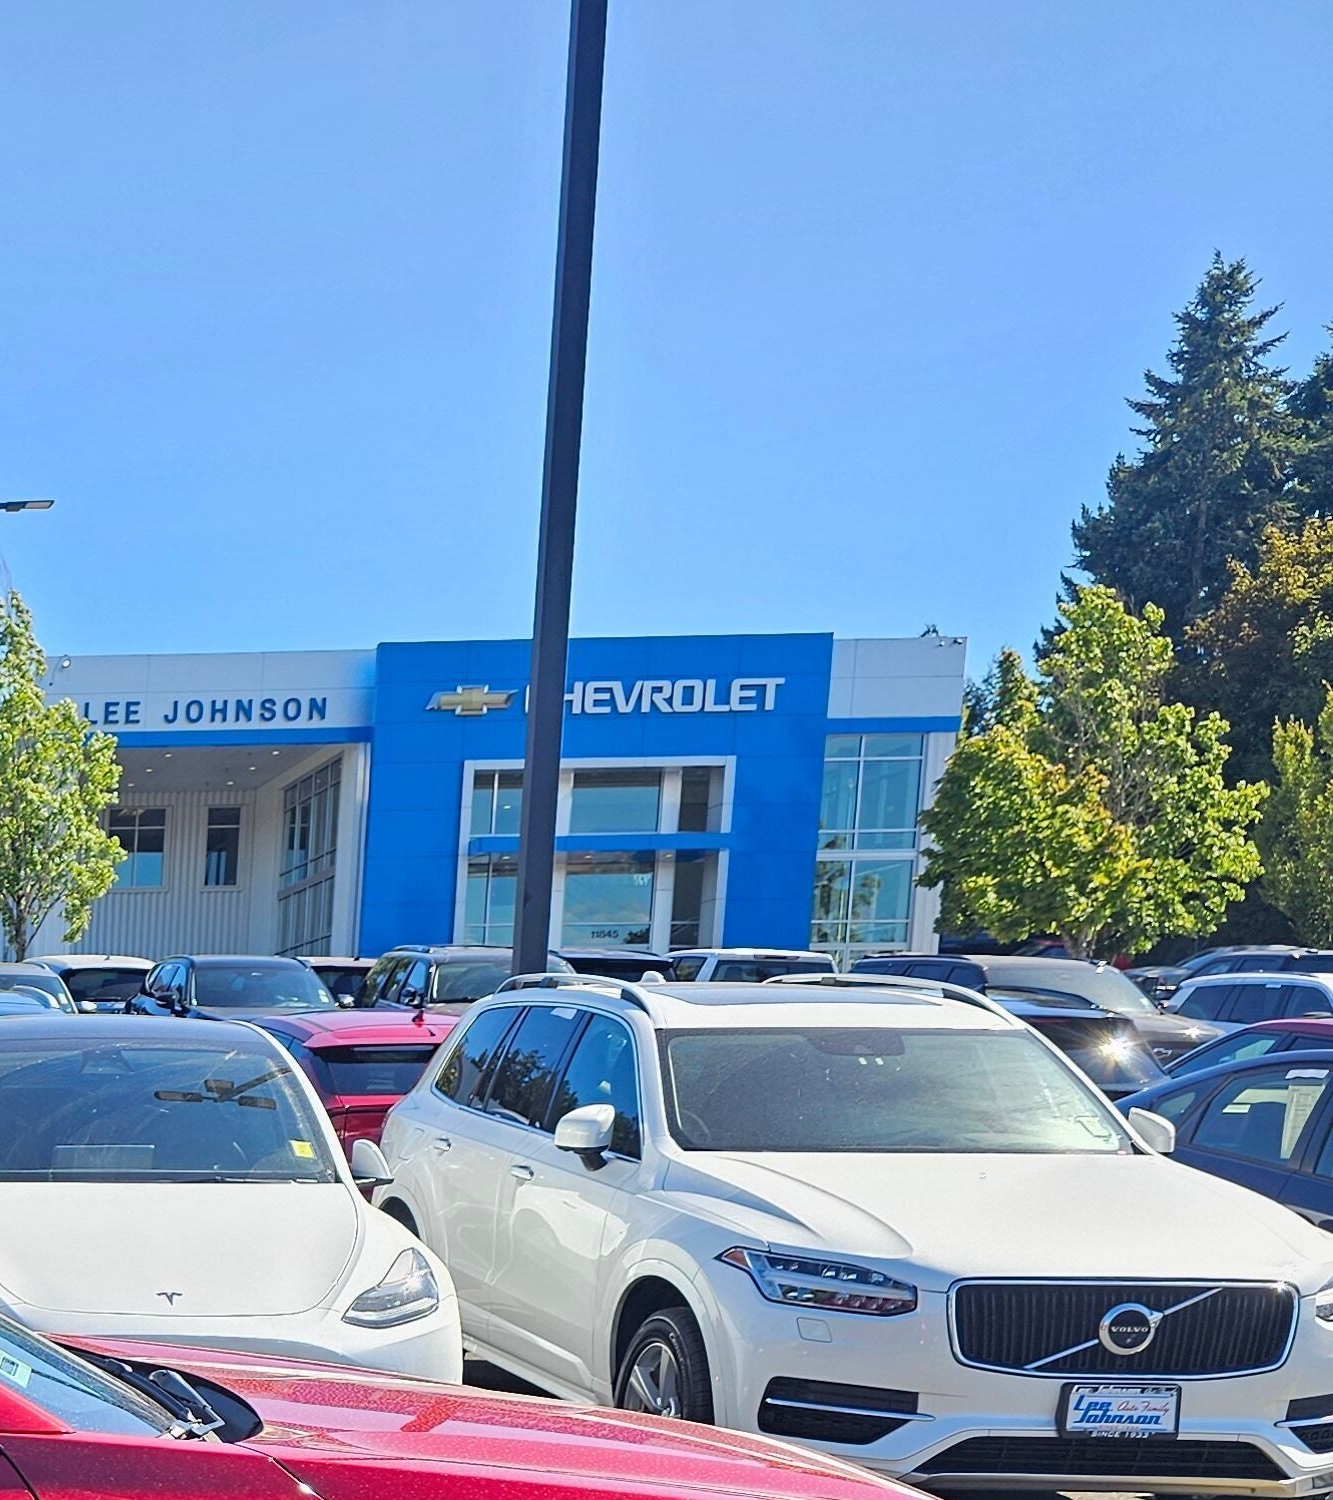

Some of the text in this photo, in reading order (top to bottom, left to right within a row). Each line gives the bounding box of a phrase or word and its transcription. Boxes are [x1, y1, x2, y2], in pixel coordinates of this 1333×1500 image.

[524, 677, 786, 714] HEVROLET
[84, 697, 328, 725] LEE JOHNSON
[1074, 1395, 1113, 1411] Lee
[1073, 1409, 1163, 1425] Johnson
